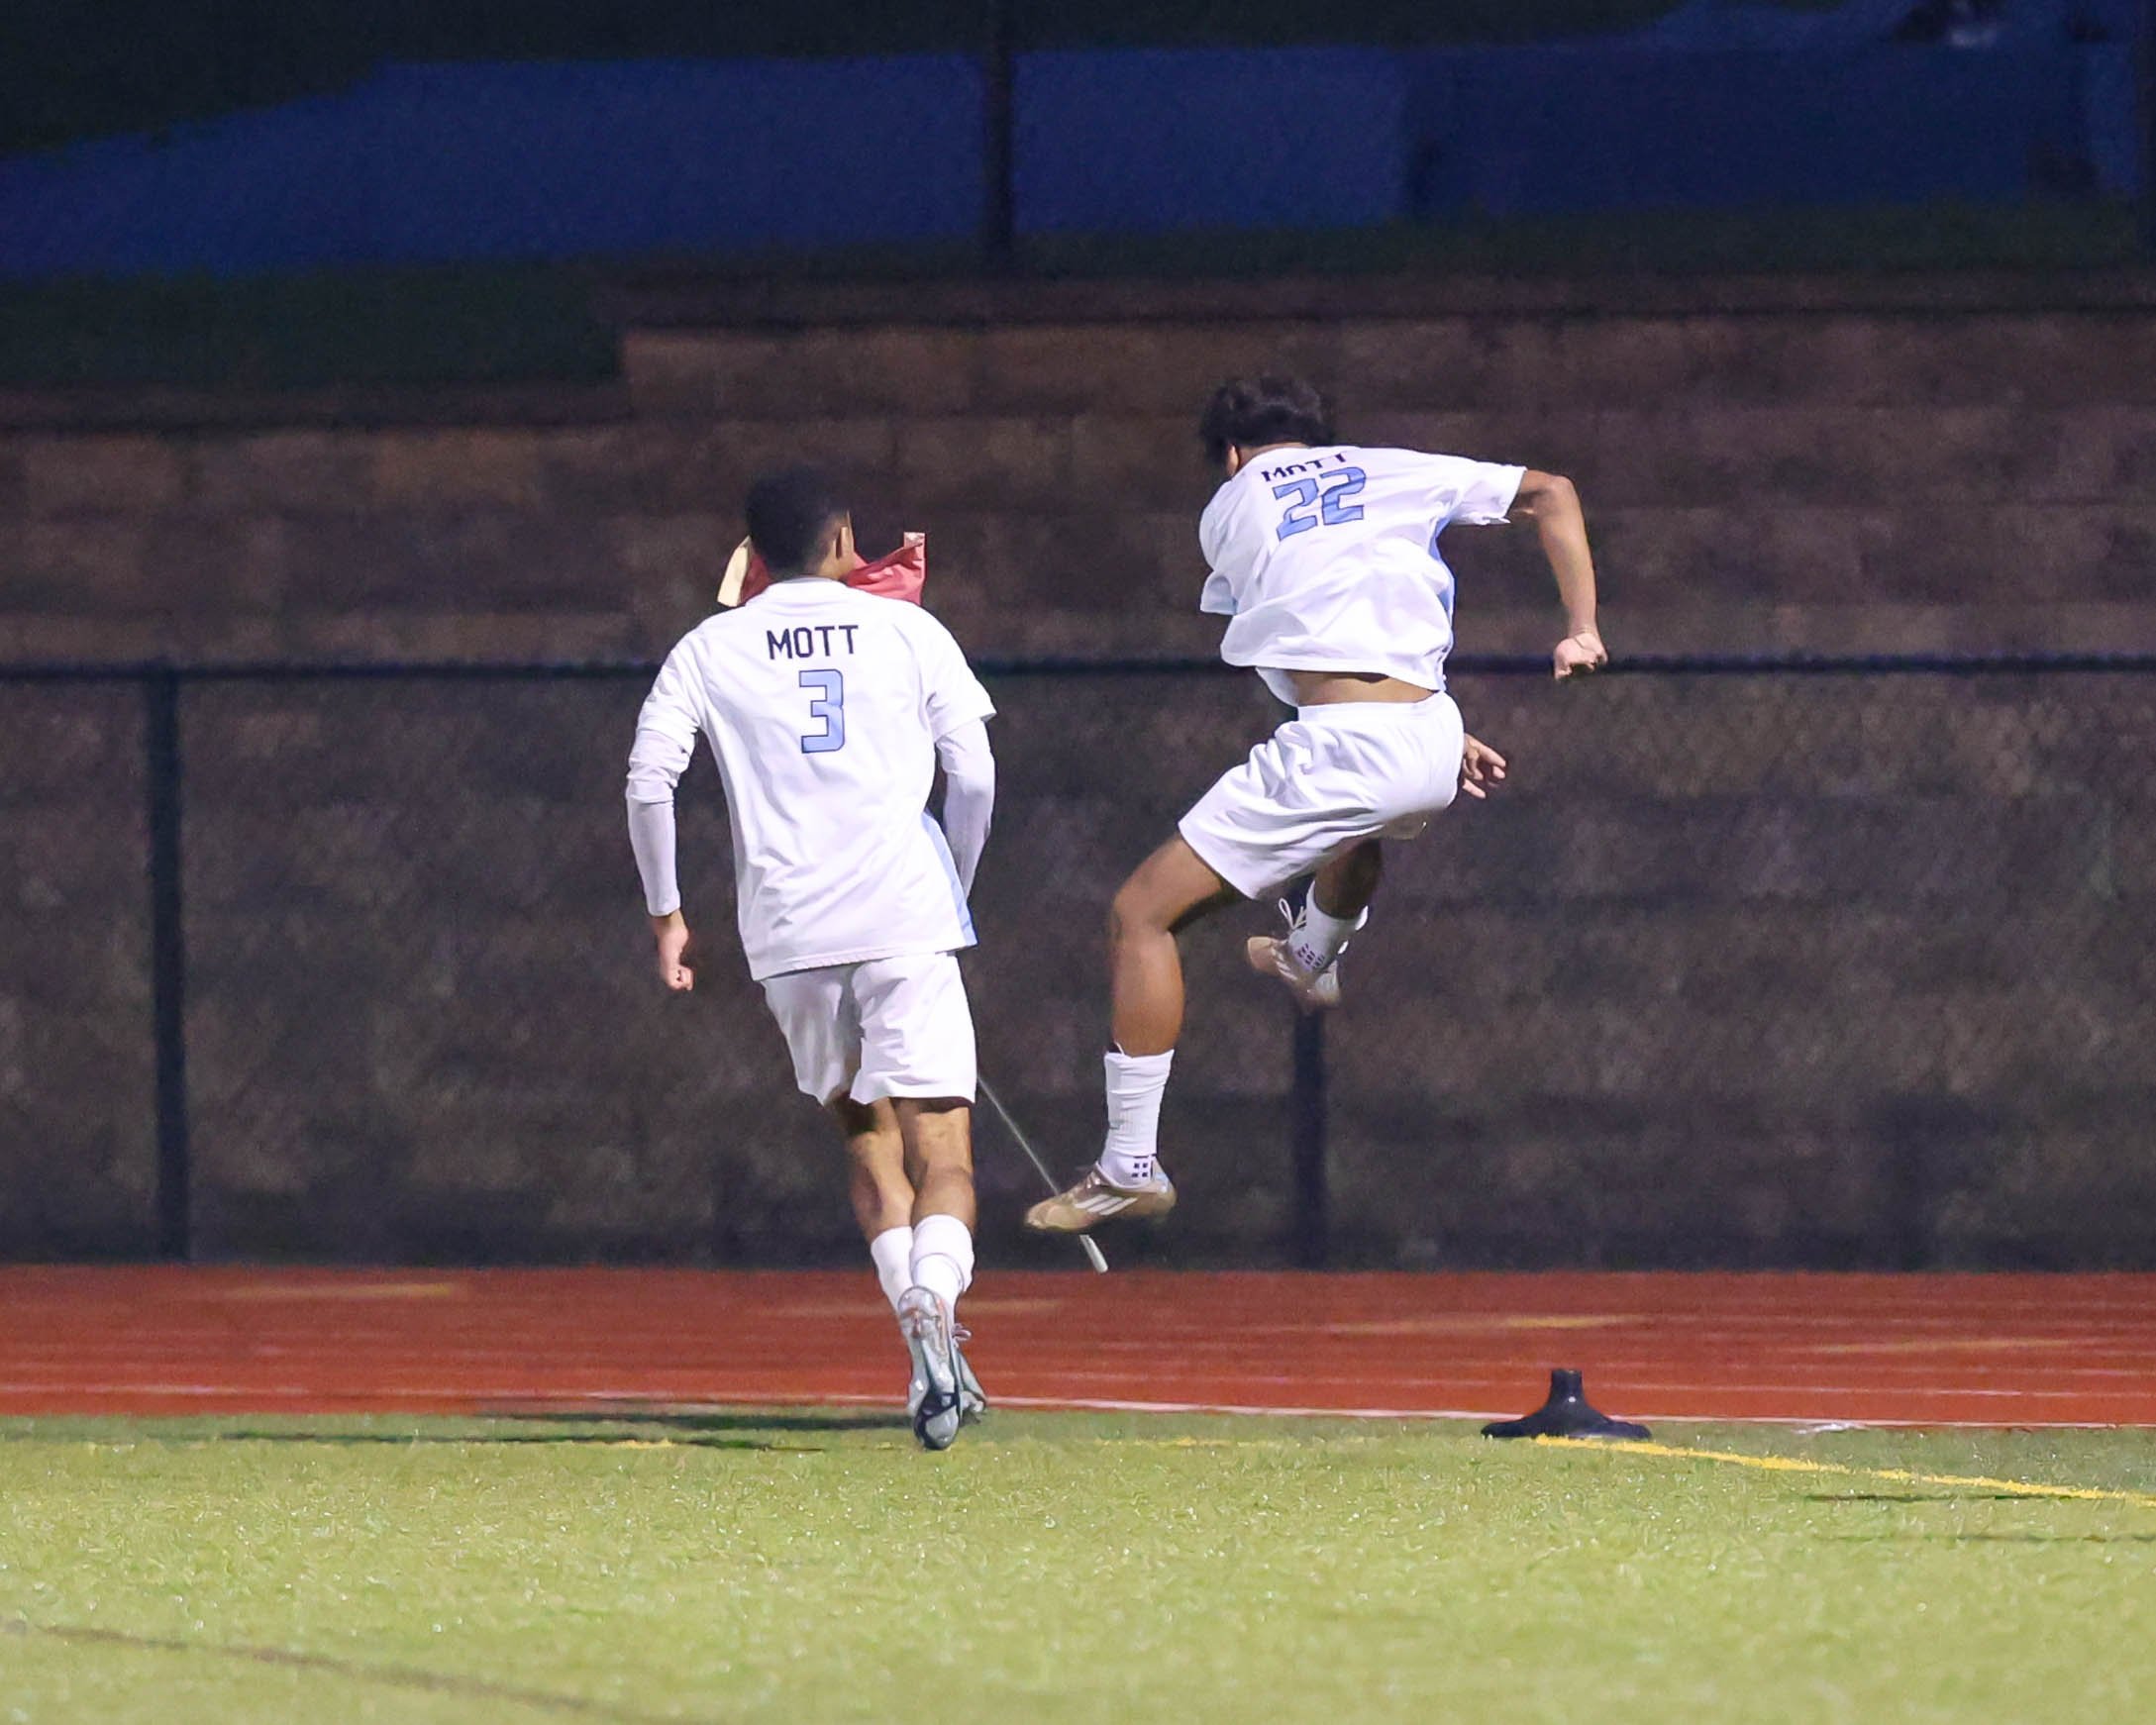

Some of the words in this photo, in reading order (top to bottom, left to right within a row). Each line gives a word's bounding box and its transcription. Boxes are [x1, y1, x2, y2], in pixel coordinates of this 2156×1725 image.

[1272, 466, 1367, 542] 22
[767, 625, 859, 660] MOTT
[799, 668, 845, 754] 3
